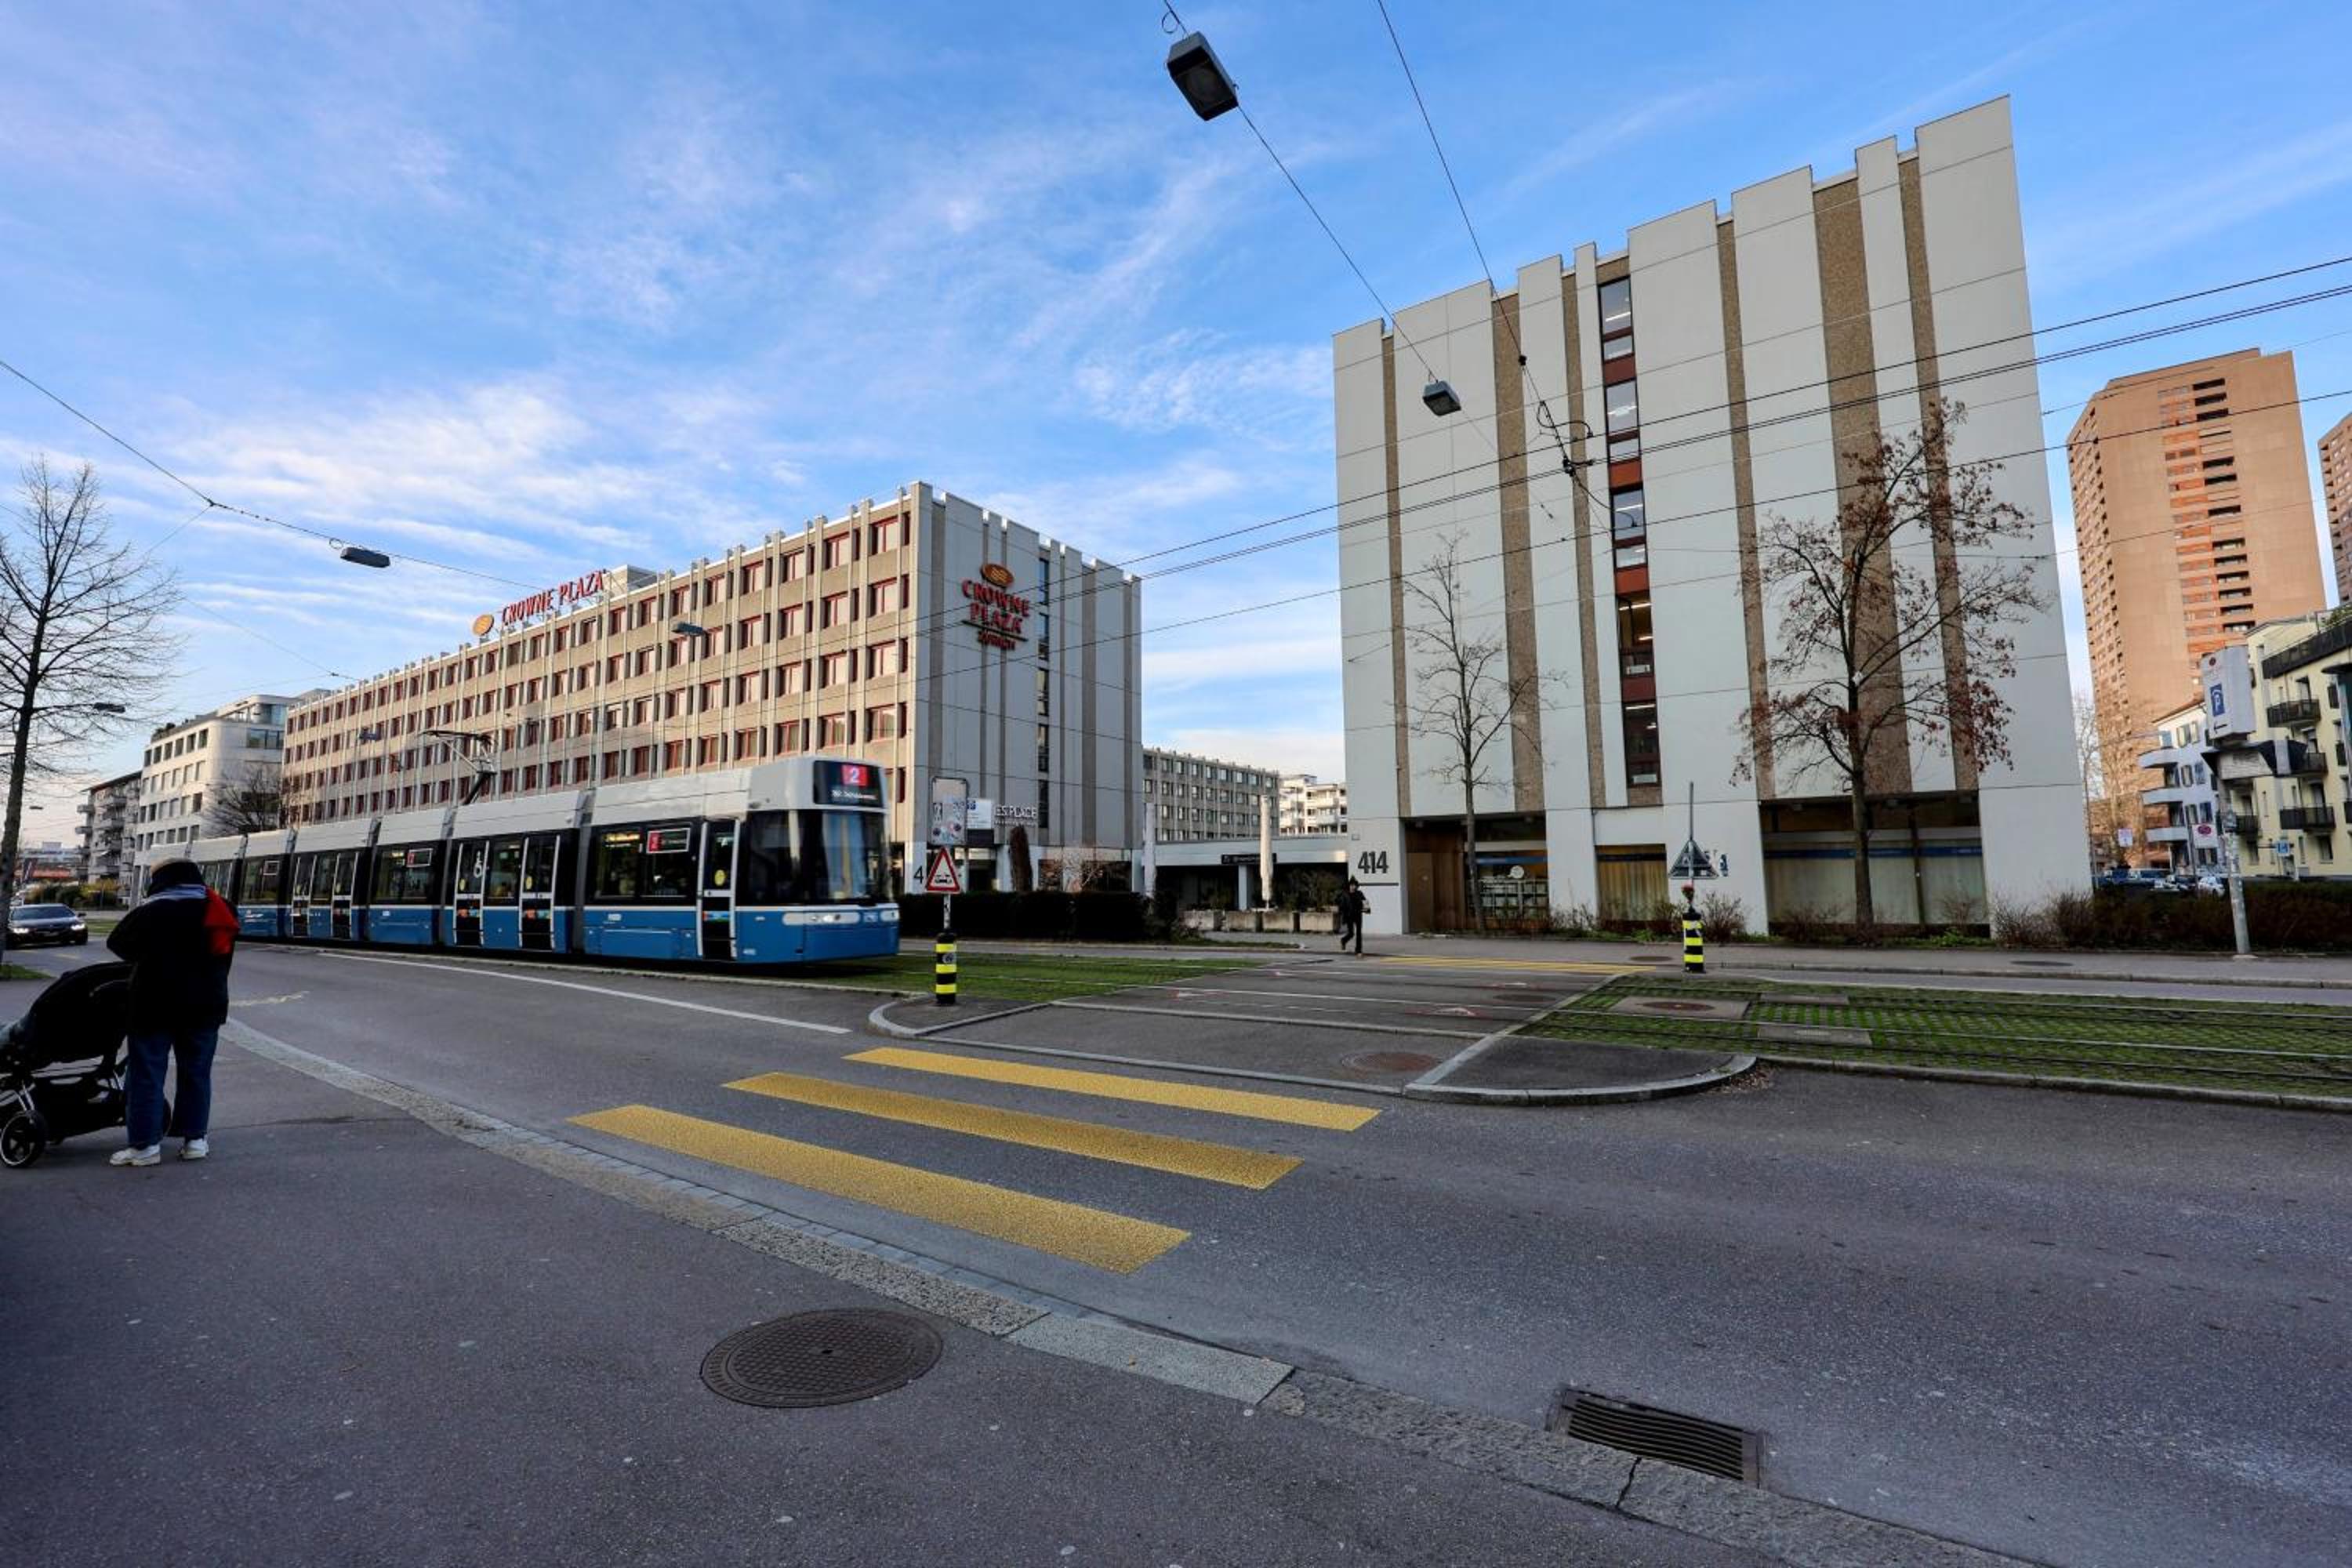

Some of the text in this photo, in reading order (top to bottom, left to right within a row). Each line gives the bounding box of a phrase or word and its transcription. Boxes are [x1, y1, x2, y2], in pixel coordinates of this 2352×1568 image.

[503, 570, 604, 626] CROWNE PLAZA
[962, 580, 1029, 617] CROWNE
[970, 602, 1022, 633] PLAZA
[849, 768, 860, 783] 2
[1358, 851, 1388, 874] 414
